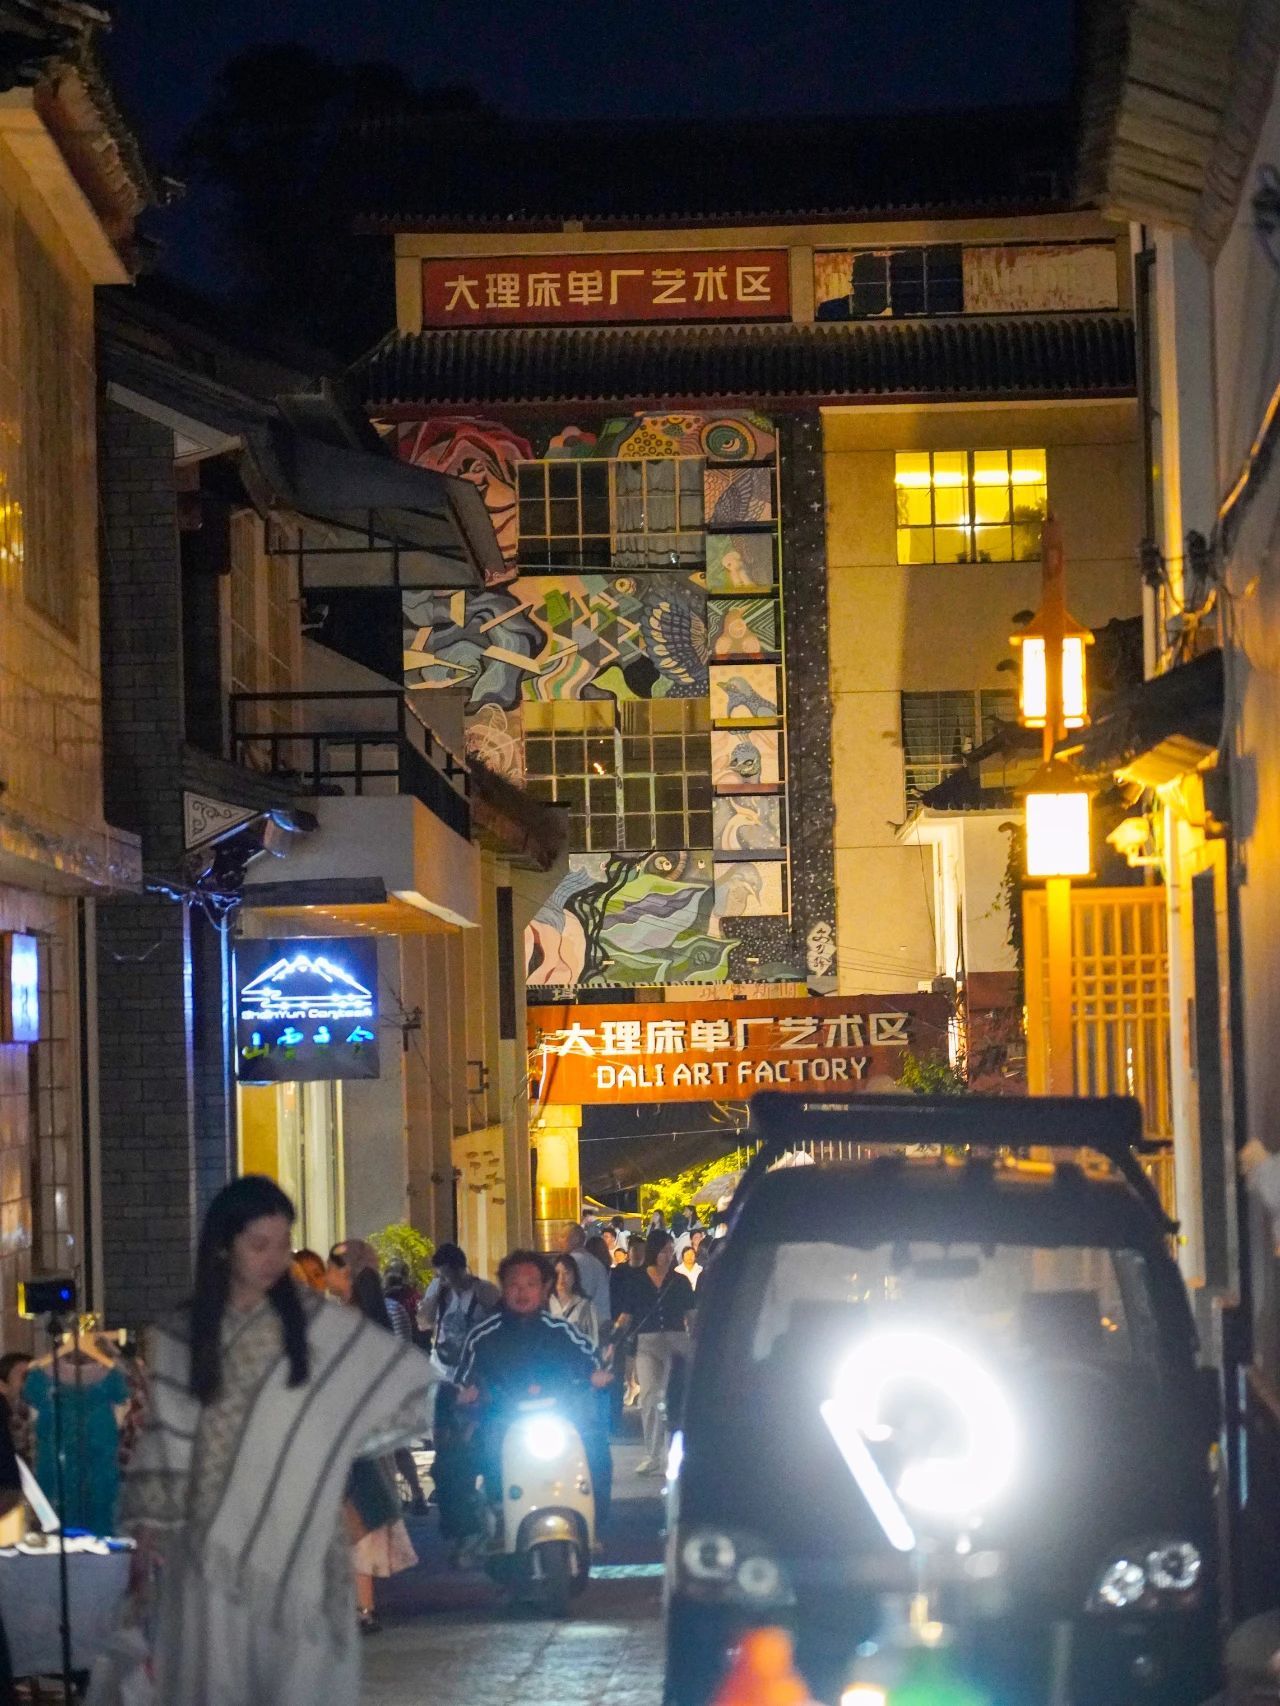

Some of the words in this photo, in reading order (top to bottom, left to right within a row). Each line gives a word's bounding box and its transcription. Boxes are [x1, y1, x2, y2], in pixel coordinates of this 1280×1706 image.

[444, 265, 771, 311] 大理床单厂艺术区
[555, 1012, 910, 1057] 大理床单厂艺术区
[596, 1063, 665, 1089] DALI
[673, 1061, 730, 1087] ART
[737, 1057, 868, 1085] FACTORY
